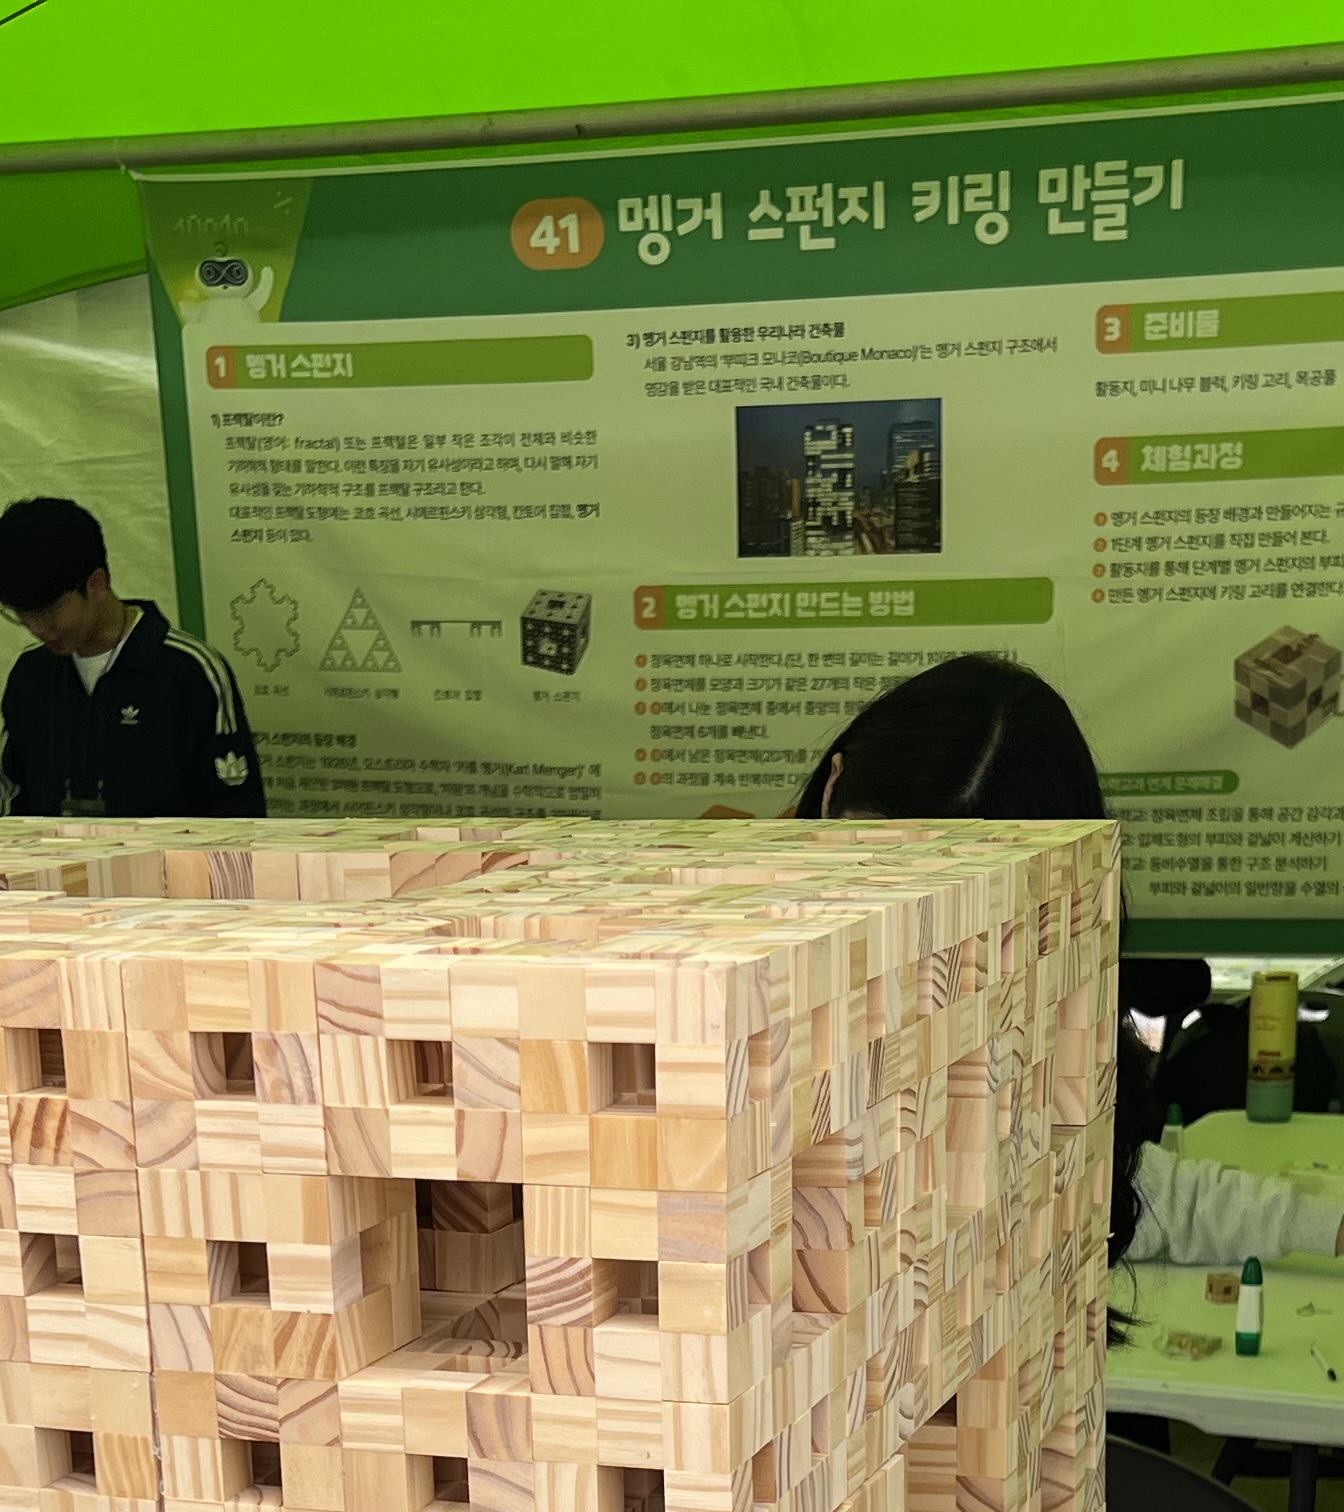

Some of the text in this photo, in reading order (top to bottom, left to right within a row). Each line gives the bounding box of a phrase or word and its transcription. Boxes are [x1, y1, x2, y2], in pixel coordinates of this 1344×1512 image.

[529, 159, 1184, 265] 41 멩거 스펀지 키링 만들기
[626, 321, 845, 349] 3) 멩거 스펀지를 활용한 우리나라 건축물
[1103, 309, 1220, 342] 3 준비물
[644, 356, 667, 372] 서울
[935, 342, 962, 358] 멩거
[964, 339, 1003, 357] 스펀지
[1005, 336, 1058, 355] 구조에서
[214, 353, 353, 379] 1 멩거 스펀지
[644, 373, 851, 397] 영감을 받은 대표적인 국내 건축물이다.
[1095, 380, 1137, 398] 활동지,
[1139, 377, 1167, 395] 미니
[1169, 376, 1196, 394] 나무
[1232, 373, 1259, 390] 키링
[1261, 371, 1293, 389] 고리,
[1295, 369, 1337, 388] 목공풀
[344, 436, 366, 450] 또는
[423, 434, 446, 449] 일부
[480, 432, 515, 447] 조각이
[520, 432, 555, 447] 전체와
[560, 429, 597, 445] 비슷한
[524, 456, 547, 471] 다시
[1102, 442, 1243, 473] 4 체험과정
[342, 482, 375, 497] 구조를
[1110, 511, 1138, 527] 멩거
[1140, 509, 1192, 525] 스펀지의
[1195, 508, 1221, 524] 등장
[1223, 505, 1263, 523] 배경과
[1265, 504, 1331, 521] 만들어지는
[1145, 536, 1172, 552] 멩거
[1173, 533, 1226, 550] 스펀지를
[1229, 532, 1255, 549] 직접
[1258, 530, 1298, 548] 만들어
[1109, 561, 1160, 578] 활동지를
[1164, 560, 1191, 577] 통해
[1192, 559, 1232, 576] 단계별
[1234, 558, 1261, 575] 멩거
[1262, 555, 1316, 573] 스펀지의
[1108, 588, 1135, 603] 만든
[1136, 587, 1164, 603] 멩거
[1165, 585, 1217, 602] 스펀지에
[1220, 584, 1247, 600] 키링
[1248, 582, 1288, 599] 고리를
[641, 590, 915, 620] 2 멩거 스펀지 만드는 방법
[1277, 807, 1303, 823] 공간
[1289, 830, 1342, 847] 계산하기
[1246, 856, 1272, 871] 구조
